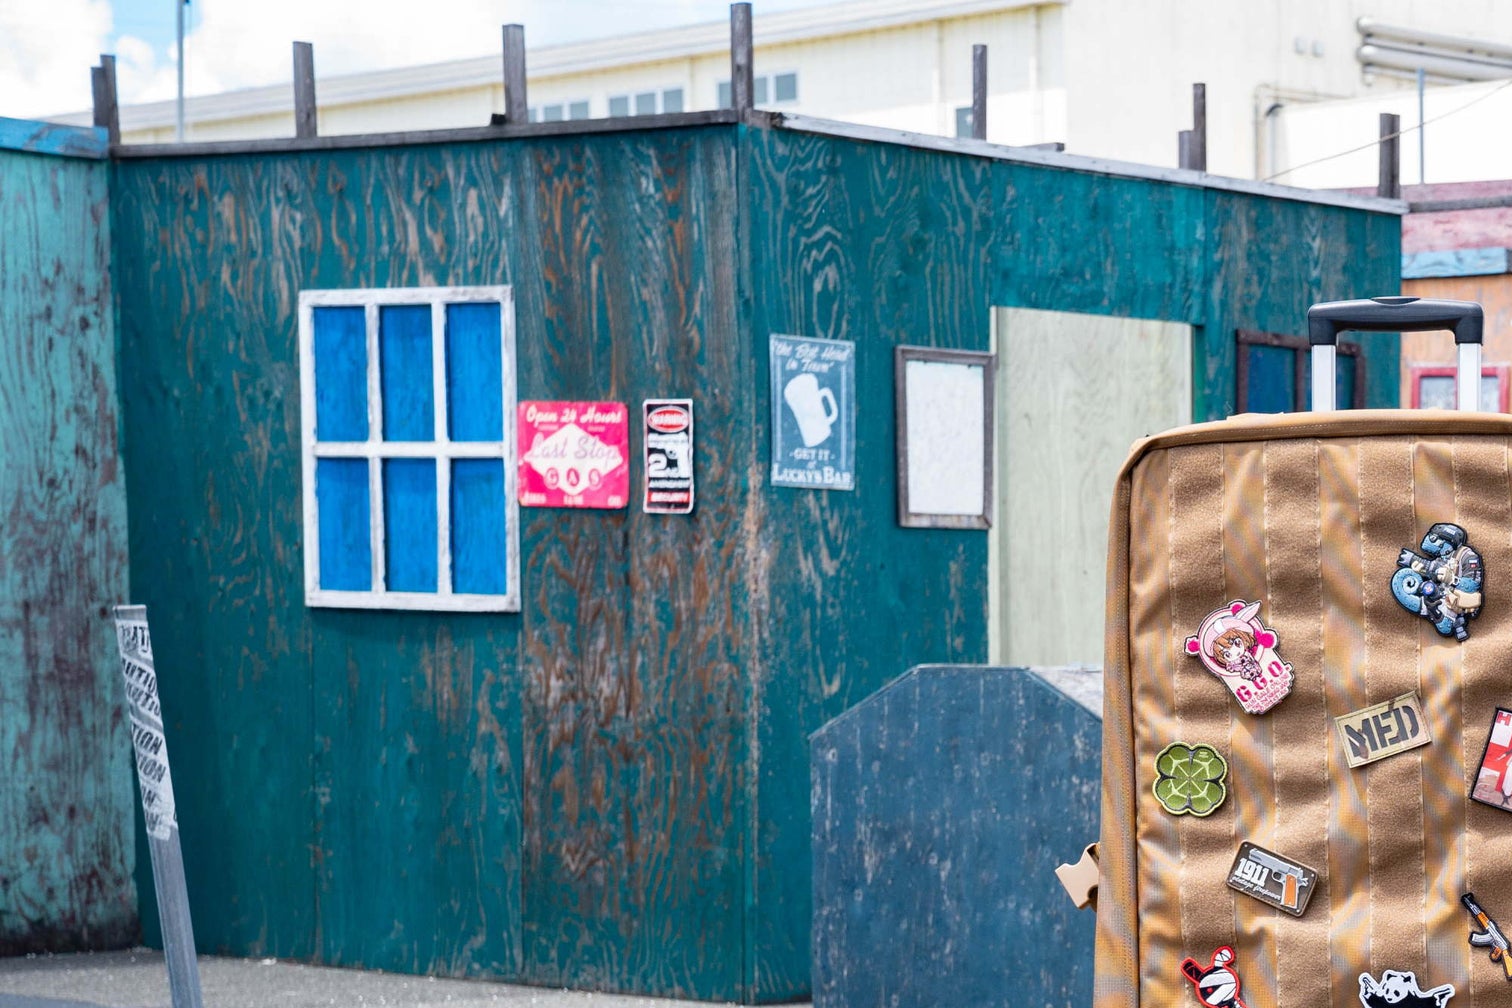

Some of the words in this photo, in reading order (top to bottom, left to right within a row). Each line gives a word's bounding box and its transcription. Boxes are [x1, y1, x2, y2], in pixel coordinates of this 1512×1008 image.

[526, 404, 558, 428] Open
[560, 408, 577, 422] 24
[579, 406, 622, 424] Hours
[526, 433, 568, 458] Last
[573, 435, 618, 468] Stop
[1344, 705, 1420, 758] MED
[1234, 858, 1270, 887] 1911
